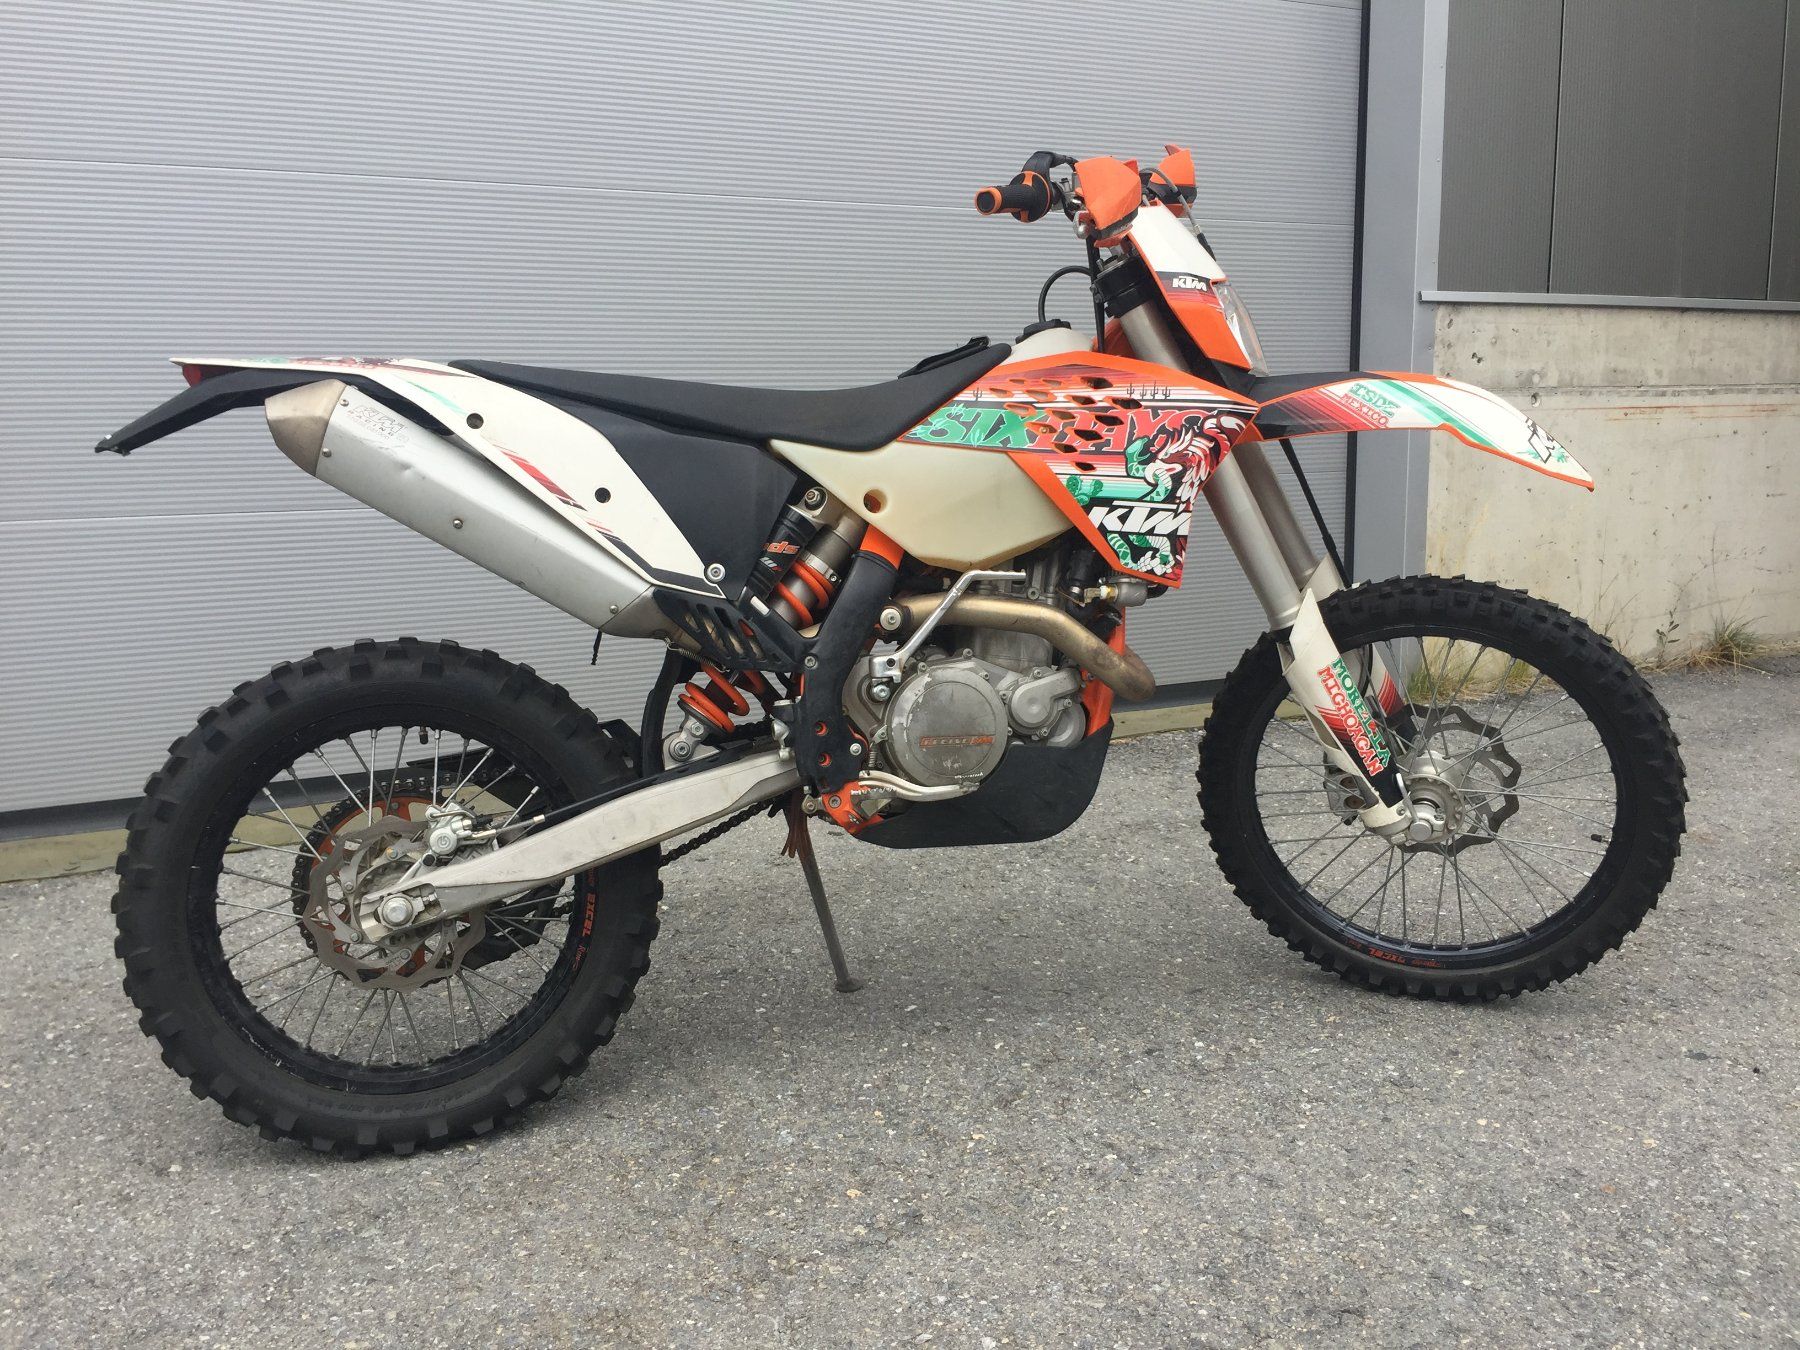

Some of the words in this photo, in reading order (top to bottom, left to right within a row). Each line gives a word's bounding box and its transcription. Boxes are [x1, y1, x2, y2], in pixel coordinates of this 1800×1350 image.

[1172, 275, 1207, 291] KTM
[1341, 393, 1388, 427] MEXICO
[1087, 500, 1192, 536] KTM
[1316, 666, 1384, 777] MICHOACAN
[582, 893, 596, 937] EXCEL
